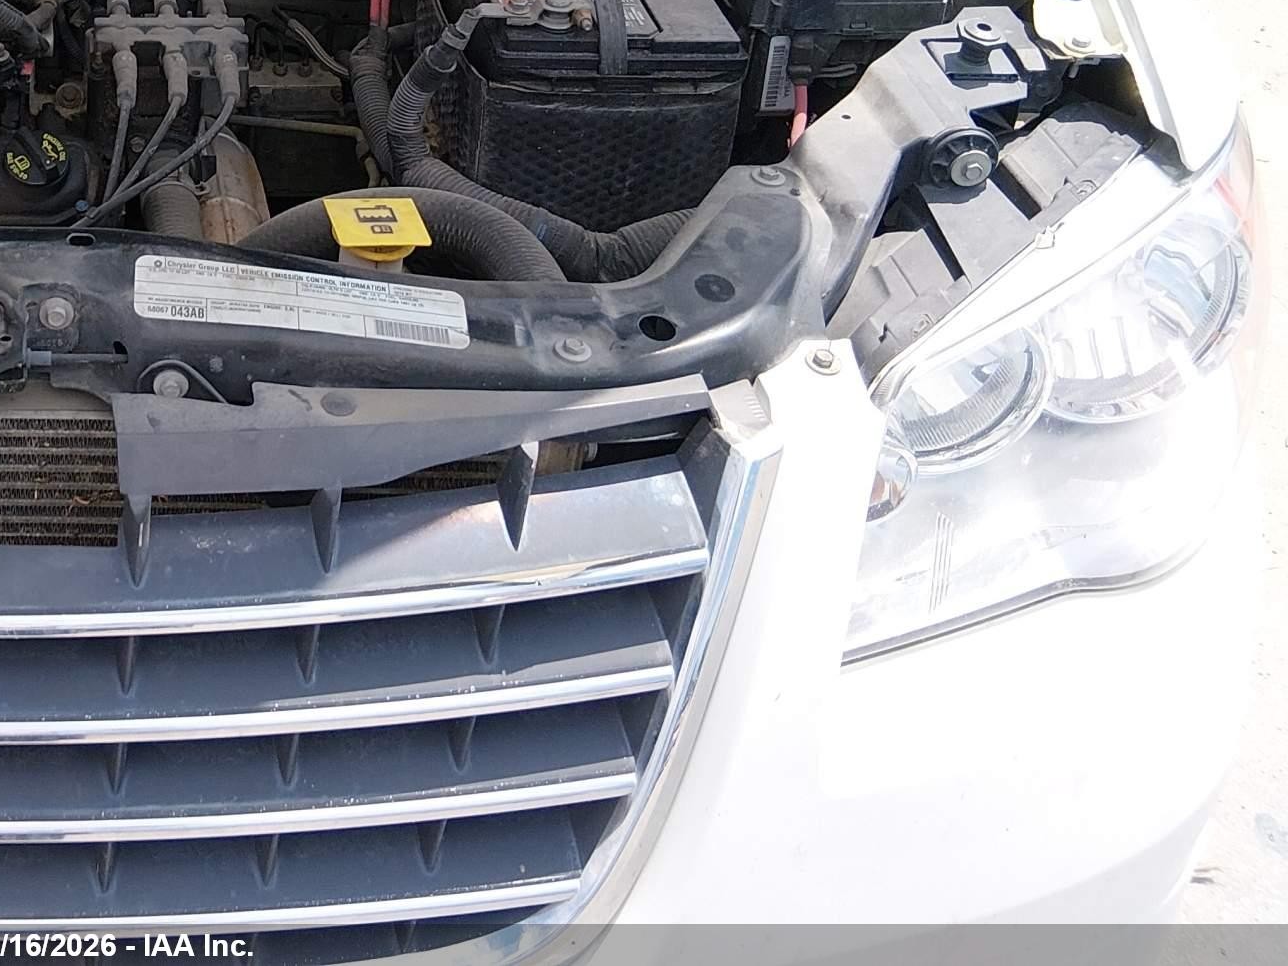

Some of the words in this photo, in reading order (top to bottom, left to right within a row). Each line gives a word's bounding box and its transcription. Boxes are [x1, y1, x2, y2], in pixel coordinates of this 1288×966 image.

[167, 260, 196, 270] Chrysler
[198, 264, 219, 273] Group
[240, 268, 268, 278] VEHICLE
[271, 272, 304, 281] EMISSION
[306, 276, 337, 286] CONTROL
[339, 281, 387, 292] INFORMATION
[170, 305, 205, 319] 043AB
